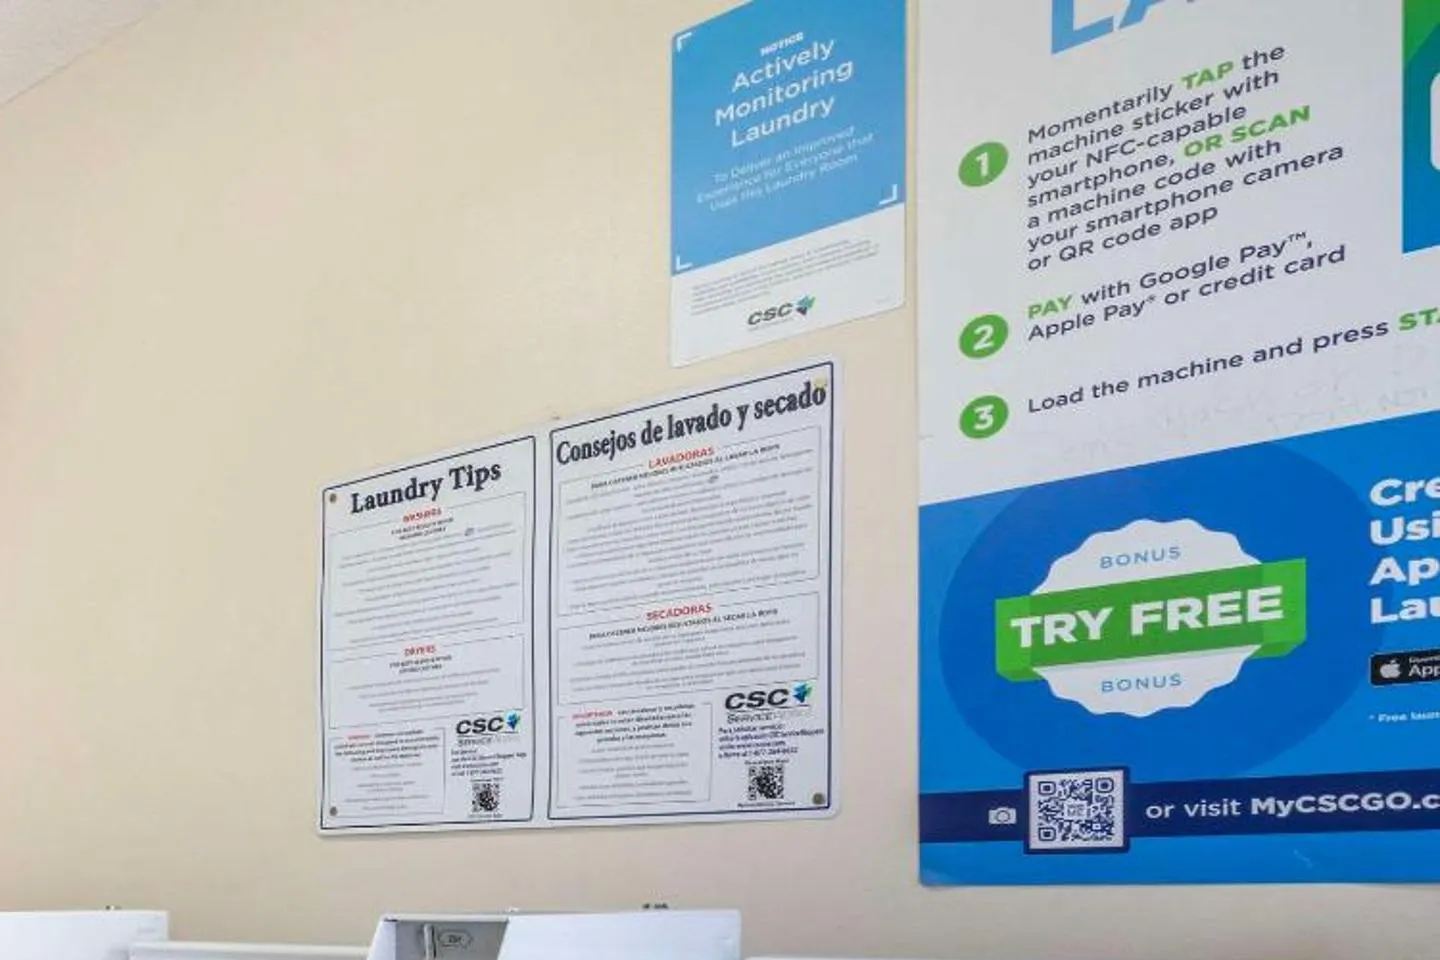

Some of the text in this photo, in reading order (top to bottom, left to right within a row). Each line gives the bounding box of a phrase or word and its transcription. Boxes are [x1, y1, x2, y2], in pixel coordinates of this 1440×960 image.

[732, 39, 835, 93] Actively
[714, 61, 853, 127] Monitoring
[1028, 46, 1285, 143] Momentarily TAP the
[1028, 70, 1279, 165] machine sticker with
[732, 96, 835, 147] Laundry
[1028, 106, 1247, 189] your NFC-capable
[976, 152, 989, 177] 1
[1028, 105, 1310, 208] smartphone, OR SCAN
[1027, 140, 1281, 229] a machine code with
[1028, 146, 1343, 252] your smartphone camera
[1028, 207, 1218, 270] or QR code app
[1028, 295, 1073, 319] PAY
[1081, 280, 1130, 306] with
[1139, 254, 1230, 289] Google
[1028, 312, 1095, 341] Apple
[1164, 287, 1190, 305] or
[1198, 264, 1275, 297] credit
[1283, 244, 1346, 274] card
[748, 303, 794, 325] CSC
[973, 324, 994, 351] 2
[1028, 307, 1440, 413] Load the machine and press ST
[556, 381, 827, 465] Consejos de lavado y secado
[973, 404, 994, 430] 3
[647, 447, 715, 469] LAVADORAS
[351, 463, 502, 513] Laundry Tips
[1099, 546, 1182, 569] BONUS
[646, 602, 713, 621] SECADORAS
[1010, 585, 1285, 648] TRY FREE
[725, 688, 790, 710] CSC
[1101, 673, 1183, 693] BONUS
[456, 717, 504, 735] CSC
[1146, 802, 1174, 819] or
[1184, 798, 1241, 817] visit
